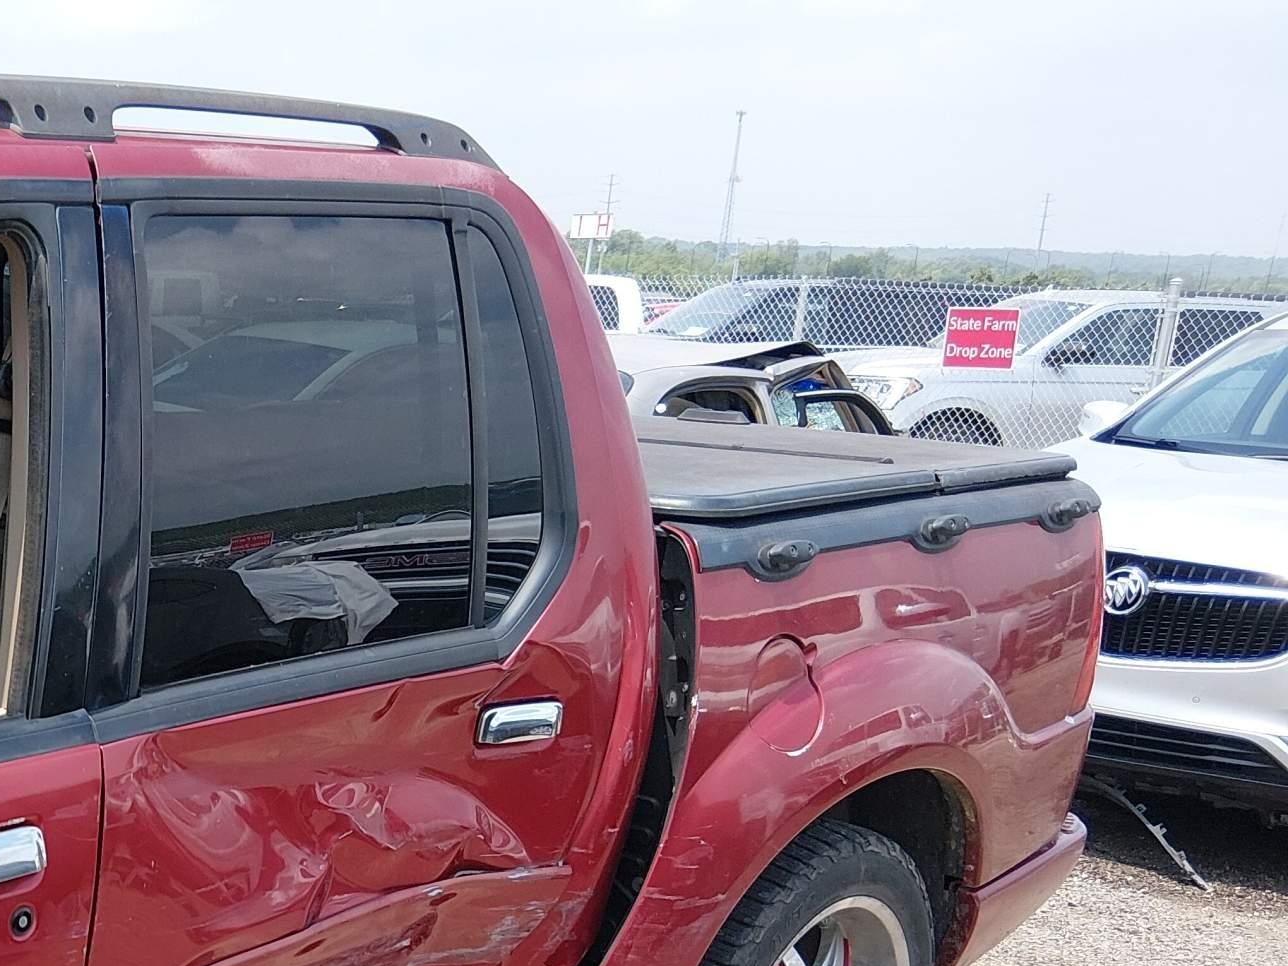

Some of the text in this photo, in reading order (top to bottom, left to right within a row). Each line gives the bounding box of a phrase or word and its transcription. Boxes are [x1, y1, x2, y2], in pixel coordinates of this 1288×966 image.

[949, 317, 1016, 332] State Farm
[946, 344, 1012, 360] Drop Zone
